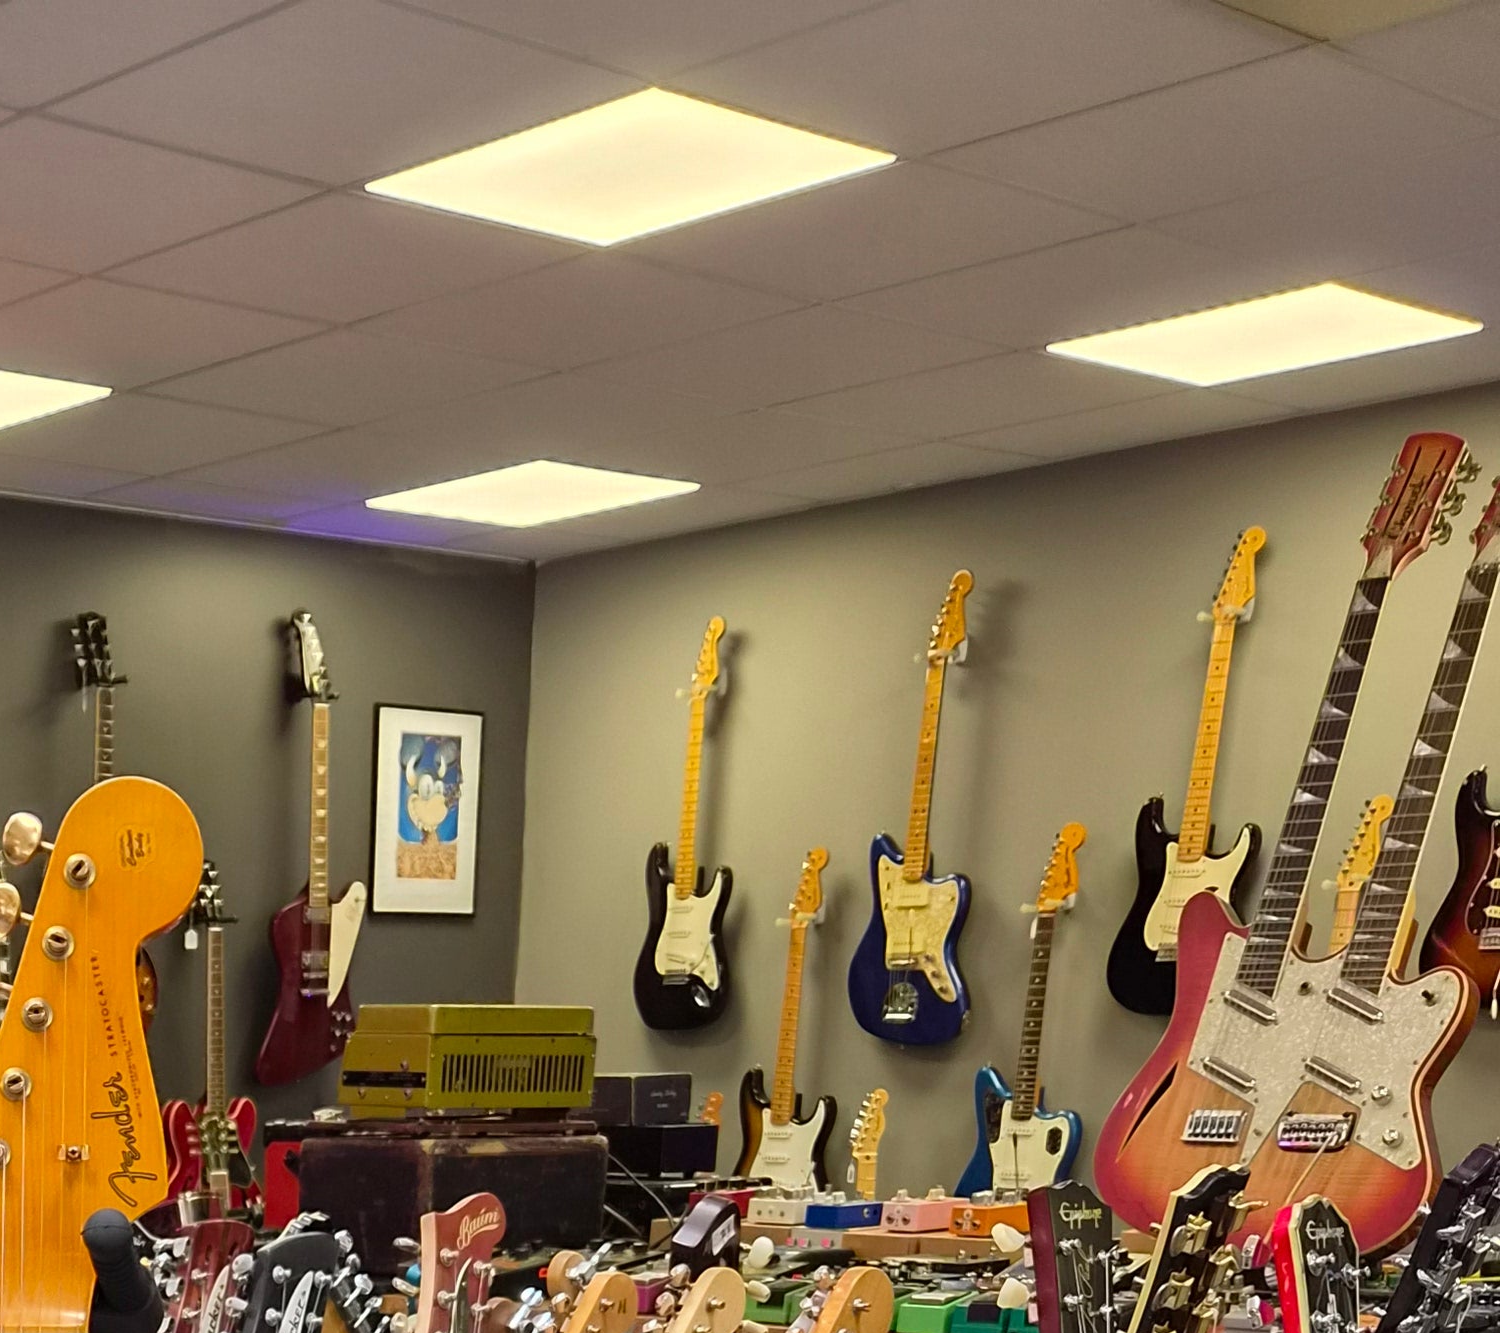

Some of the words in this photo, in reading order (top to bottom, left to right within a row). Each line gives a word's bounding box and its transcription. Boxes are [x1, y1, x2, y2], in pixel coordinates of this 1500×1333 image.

[90, 956, 118, 1057] STRATOCASTER
[90, 1071, 158, 1208] Fender
[1059, 1200, 1102, 1230] Epiphone
[1305, 1218, 1345, 1250] Epiphone
